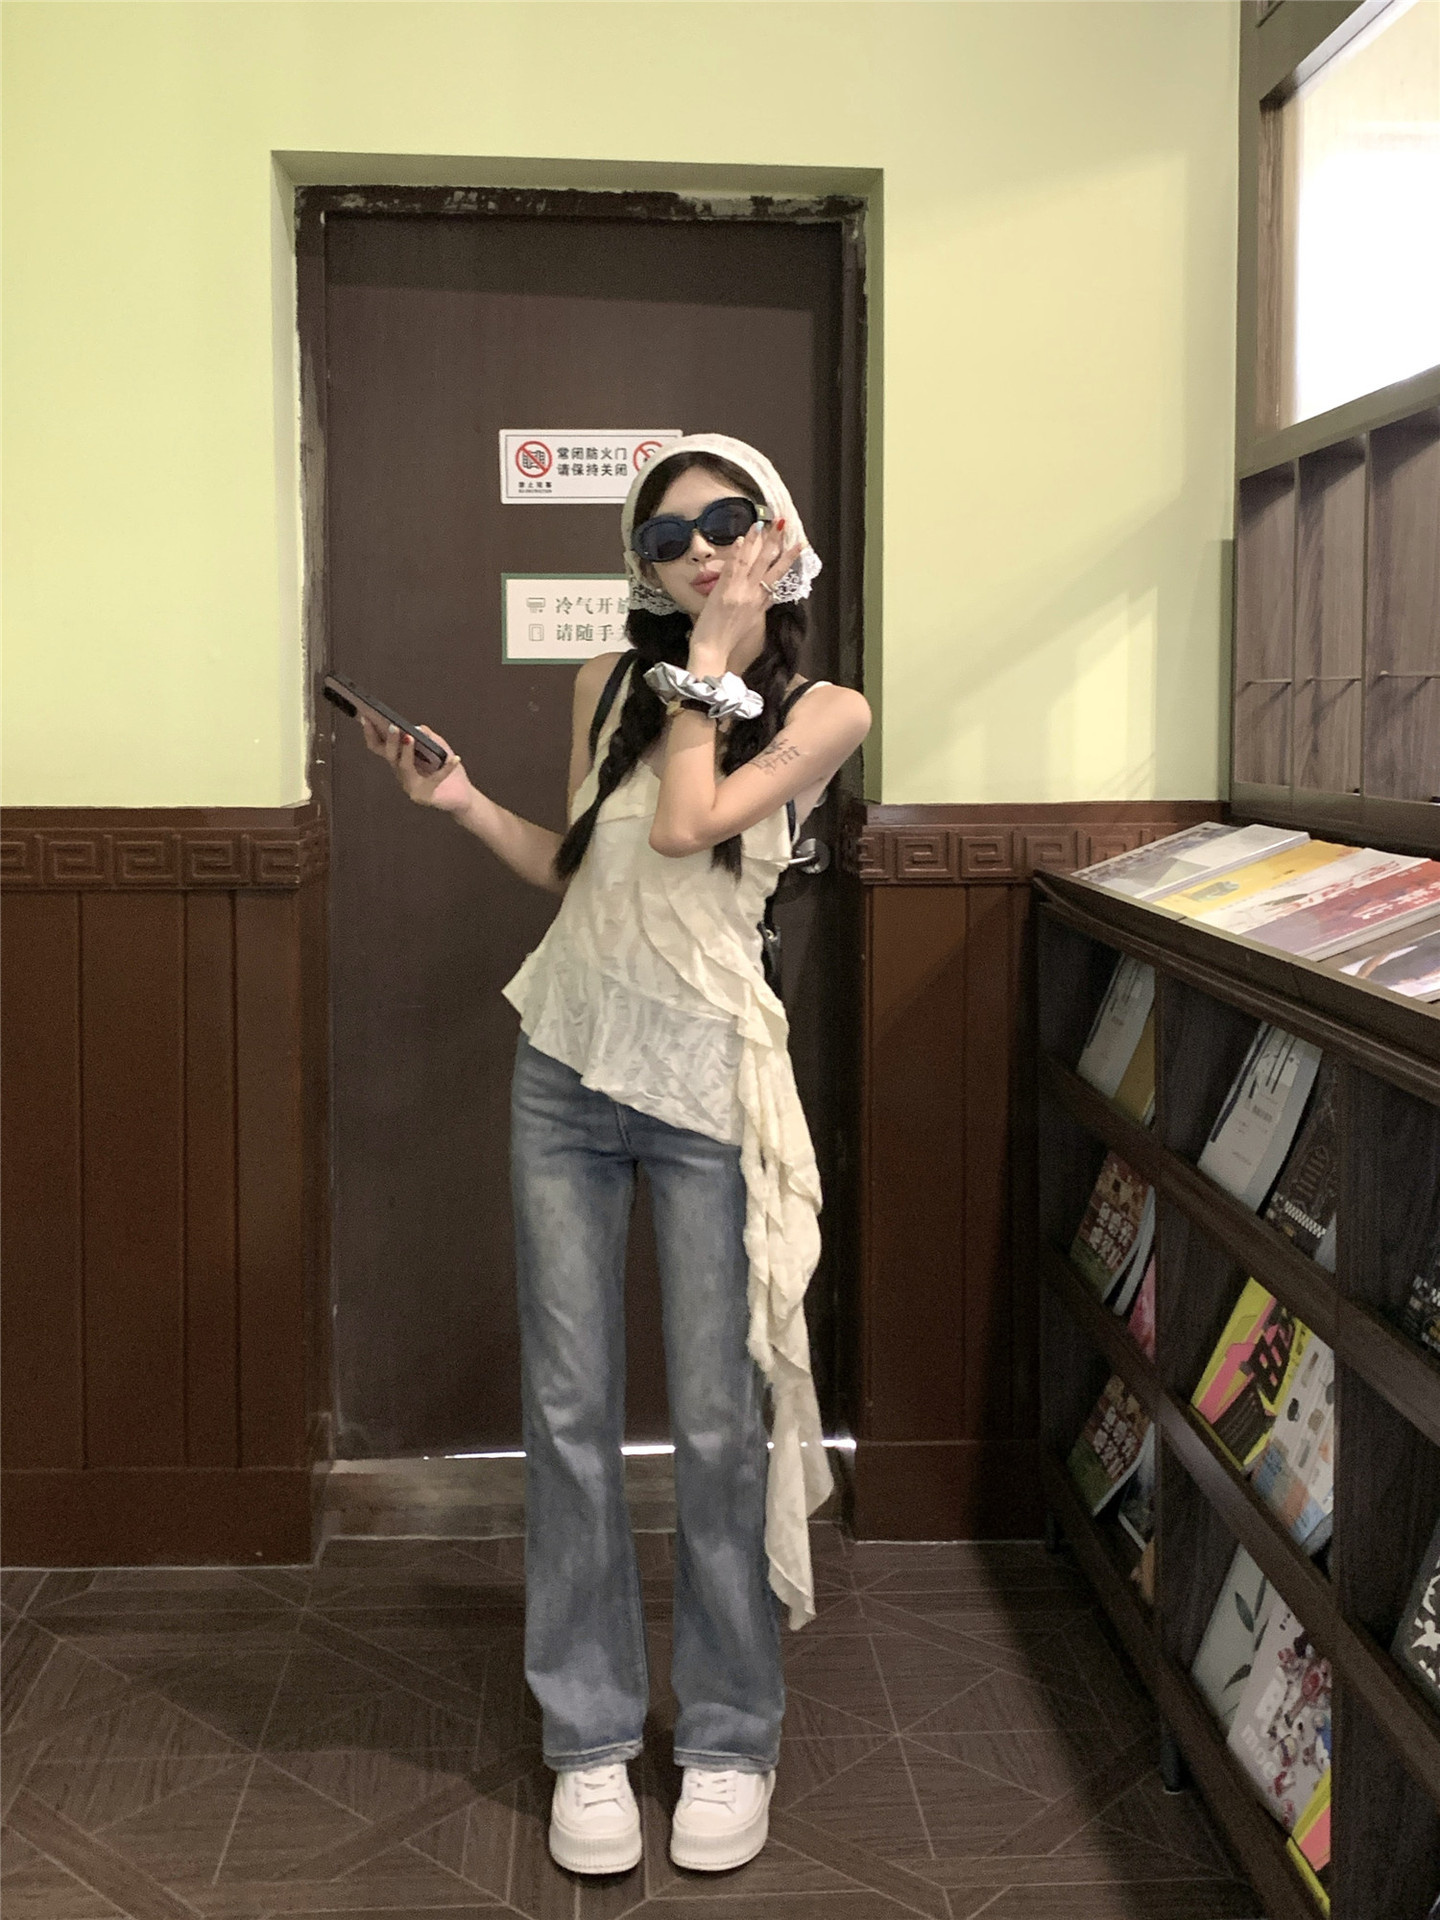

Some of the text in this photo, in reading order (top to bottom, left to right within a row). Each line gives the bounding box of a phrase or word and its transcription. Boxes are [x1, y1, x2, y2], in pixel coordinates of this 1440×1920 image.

[557, 447, 627, 460] 常闭防火门
[557, 463, 627, 476] 请保持关闭
